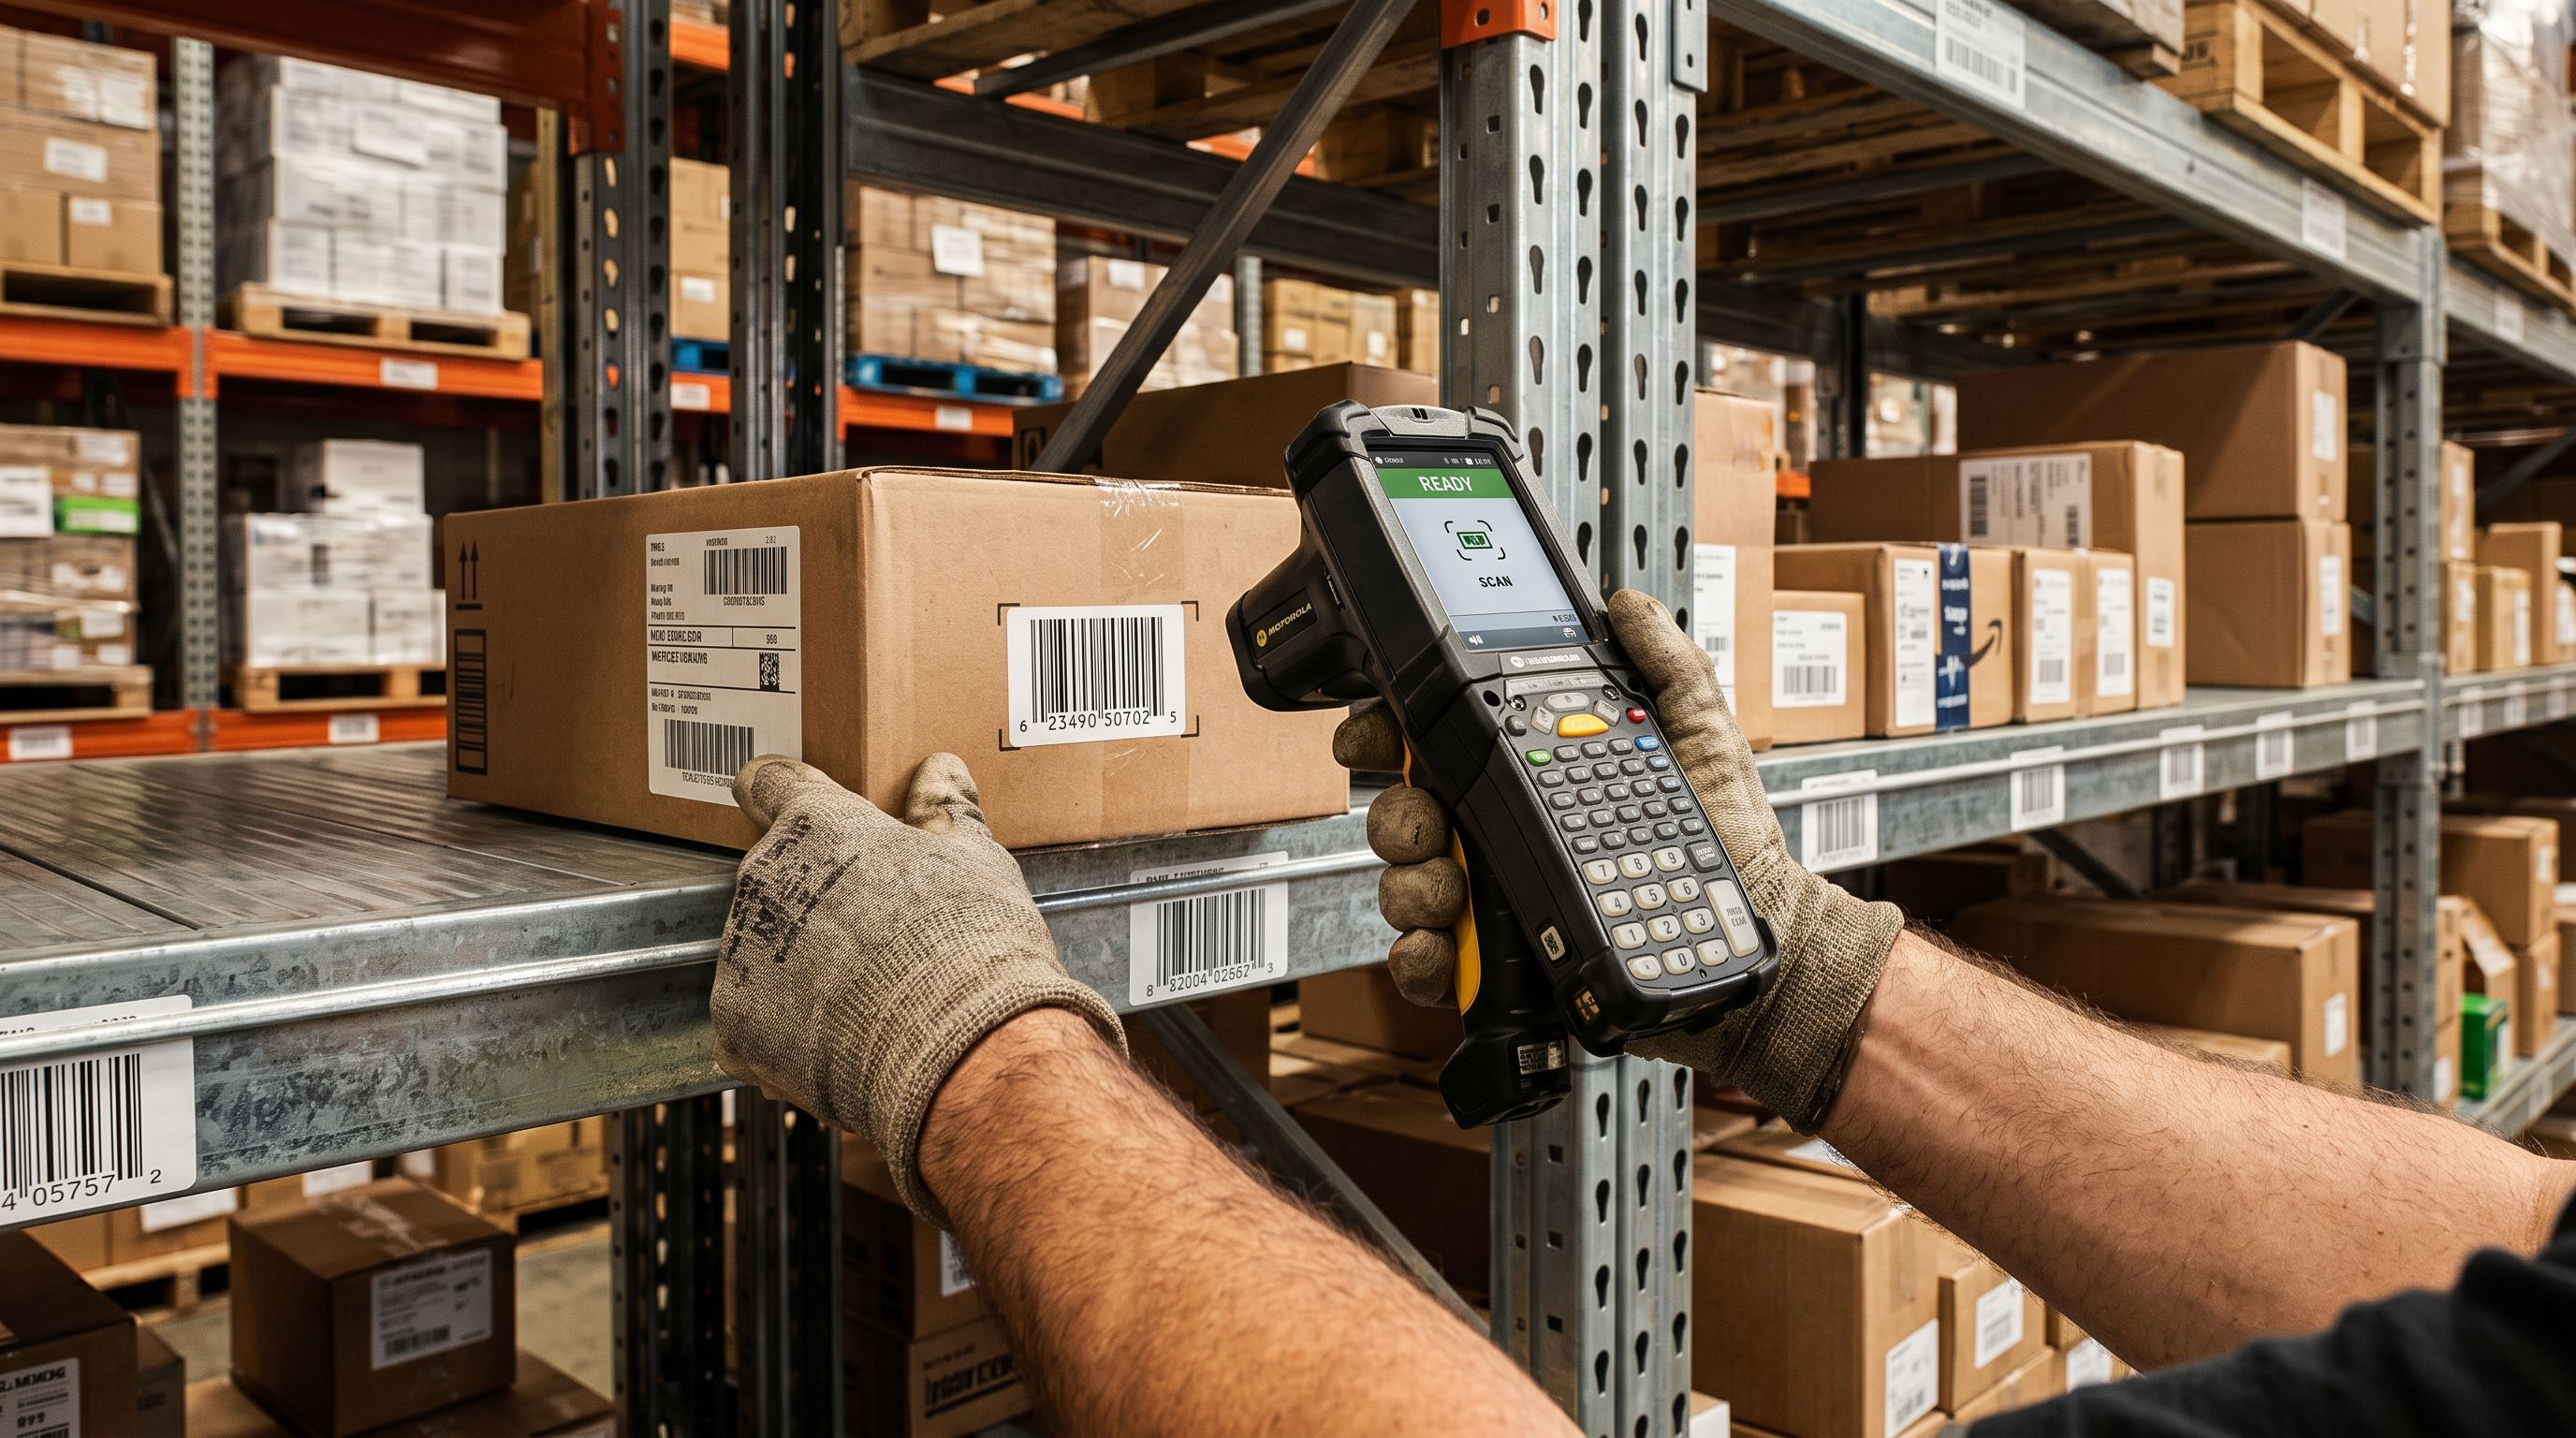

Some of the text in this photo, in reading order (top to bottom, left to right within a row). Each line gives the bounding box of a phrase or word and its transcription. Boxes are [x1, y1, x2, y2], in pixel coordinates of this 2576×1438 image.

[1418, 476, 1473, 492] READY
[1478, 576, 1513, 588] SCAN
[1267, 602, 1312, 637] MOTOROLA
[1019, 710, 1177, 732] 6 23490 50702 5
[1599, 852, 1676, 877] 7 8 9
[1615, 883, 1691, 909] 4 5 6
[1629, 913, 1706, 942] 1 2 3
[1678, 953, 1687, 966] 0
[1147, 984, 1154, 997] 8
[1169, 973, 1208, 992] 82004
[1267, 962, 1274, 974] 3
[1, 1169, 162, 1211] 4 05757 2
